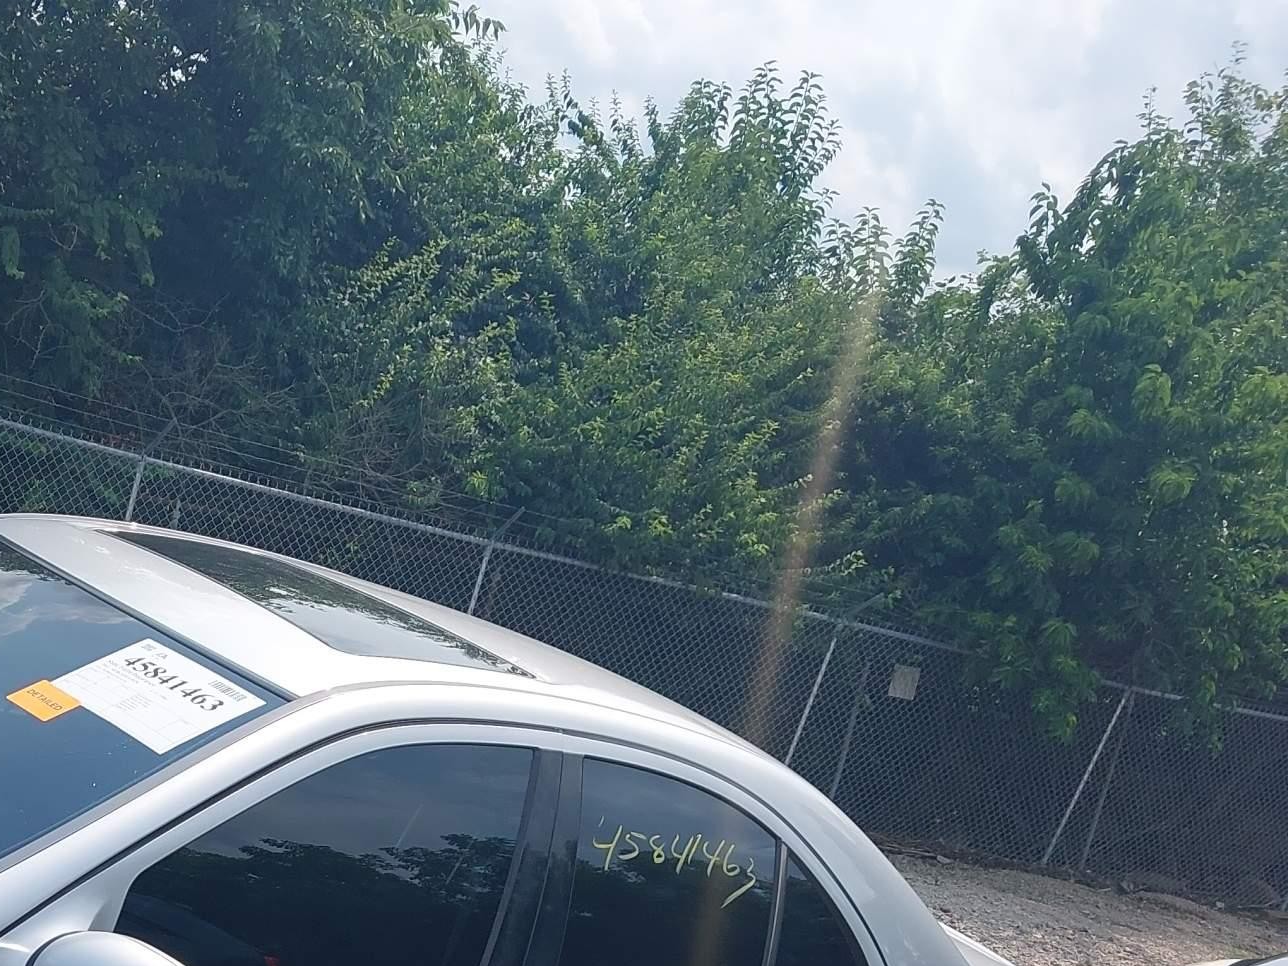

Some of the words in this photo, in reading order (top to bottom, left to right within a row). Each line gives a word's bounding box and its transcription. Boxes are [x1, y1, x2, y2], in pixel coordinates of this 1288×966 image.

[26, 688, 64, 711] DETAILED
[124, 657, 224, 711] 45841463
[593, 816, 756, 909] 45841463
